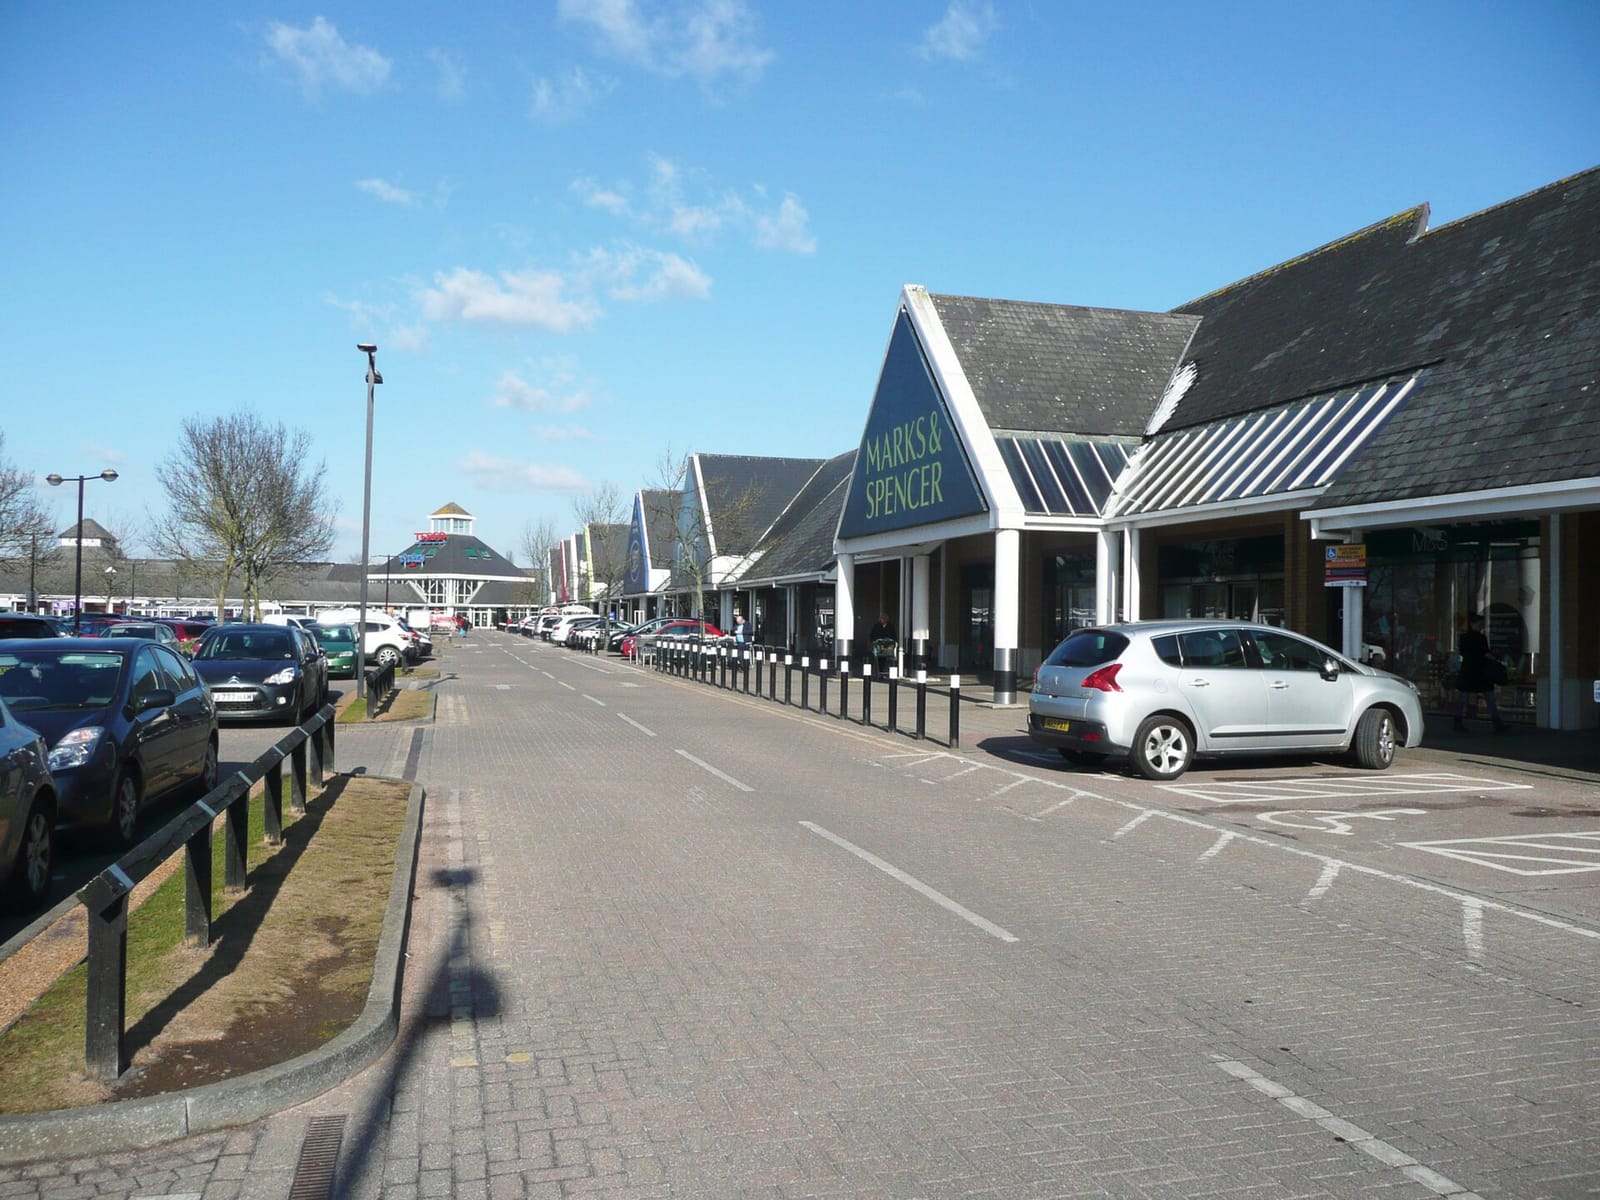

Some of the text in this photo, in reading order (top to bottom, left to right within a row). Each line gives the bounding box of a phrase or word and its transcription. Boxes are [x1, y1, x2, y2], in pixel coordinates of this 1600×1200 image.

[866, 410, 943, 475] MARKS &
[865, 461, 944, 520] SPENCER
